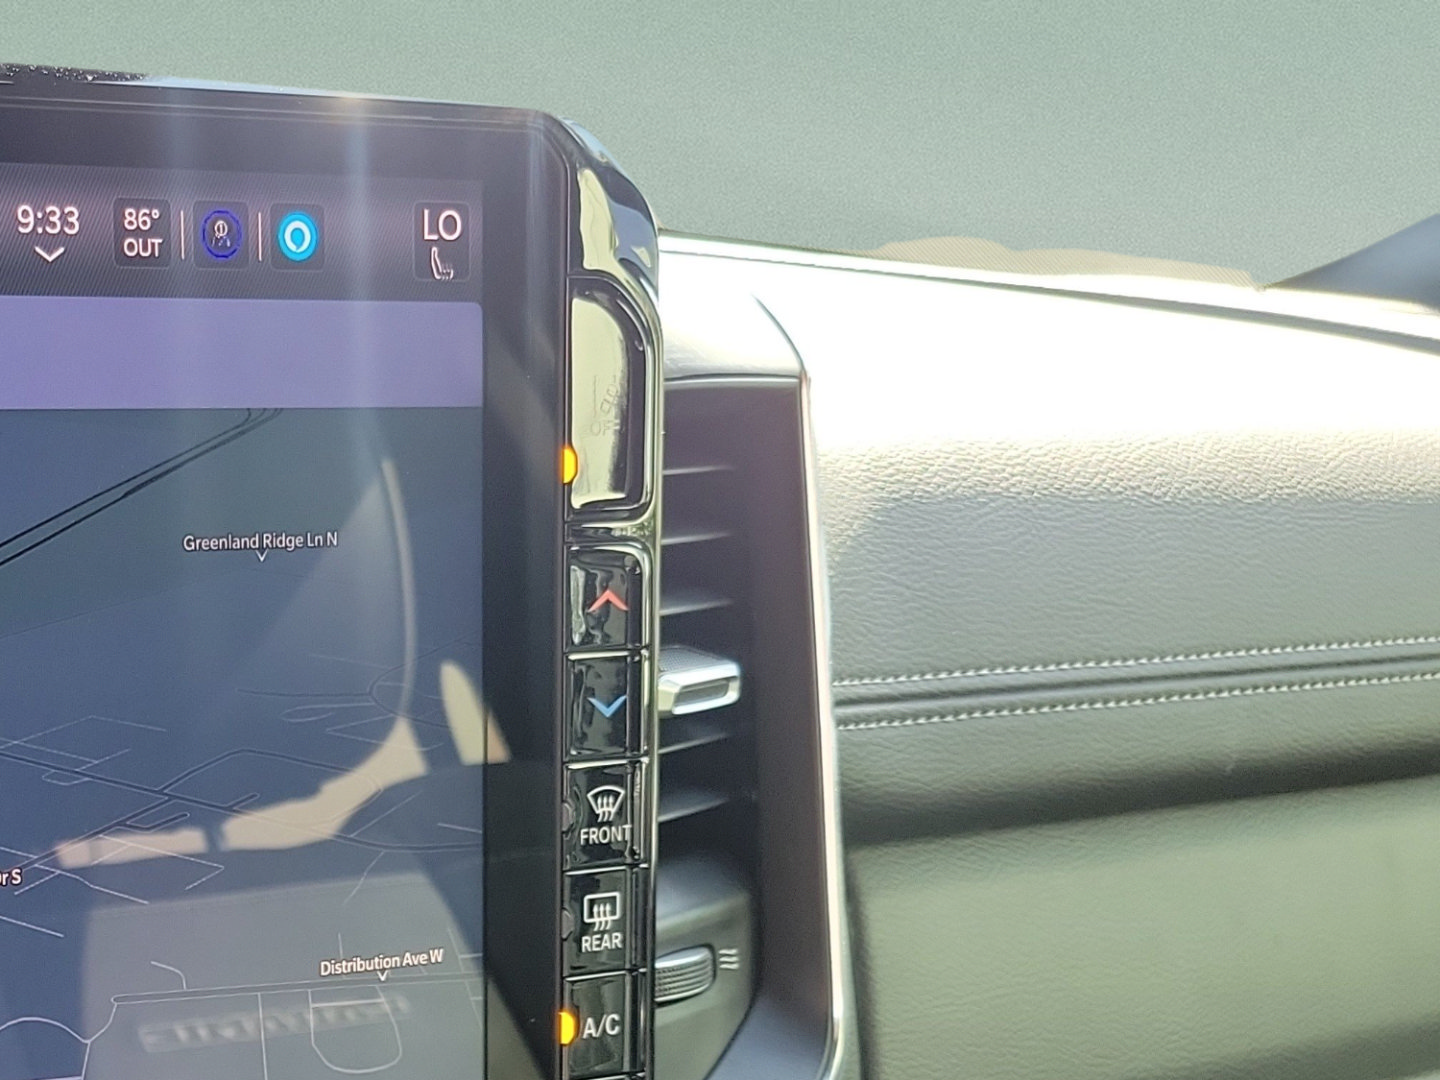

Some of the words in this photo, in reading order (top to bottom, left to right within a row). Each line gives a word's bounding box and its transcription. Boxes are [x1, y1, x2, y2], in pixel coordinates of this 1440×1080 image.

[16, 204, 80, 235] 9:33
[122, 207, 161, 232] 86°
[422, 208, 462, 241] LO
[122, 237, 163, 258] OUT
[182, 532, 260, 551] Greenland
[262, 531, 304, 552] Ridge
[306, 531, 324, 547] Ln
[326, 530, 339, 546] N
[580, 823, 633, 846] FRONT
[10, 868, 22, 885] S
[580, 931, 623, 954] REAR
[319, 955, 401, 977] Distribution
[401, 951, 429, 967] Ave
[429, 947, 444, 963] W
[582, 1012, 621, 1040] A/C
